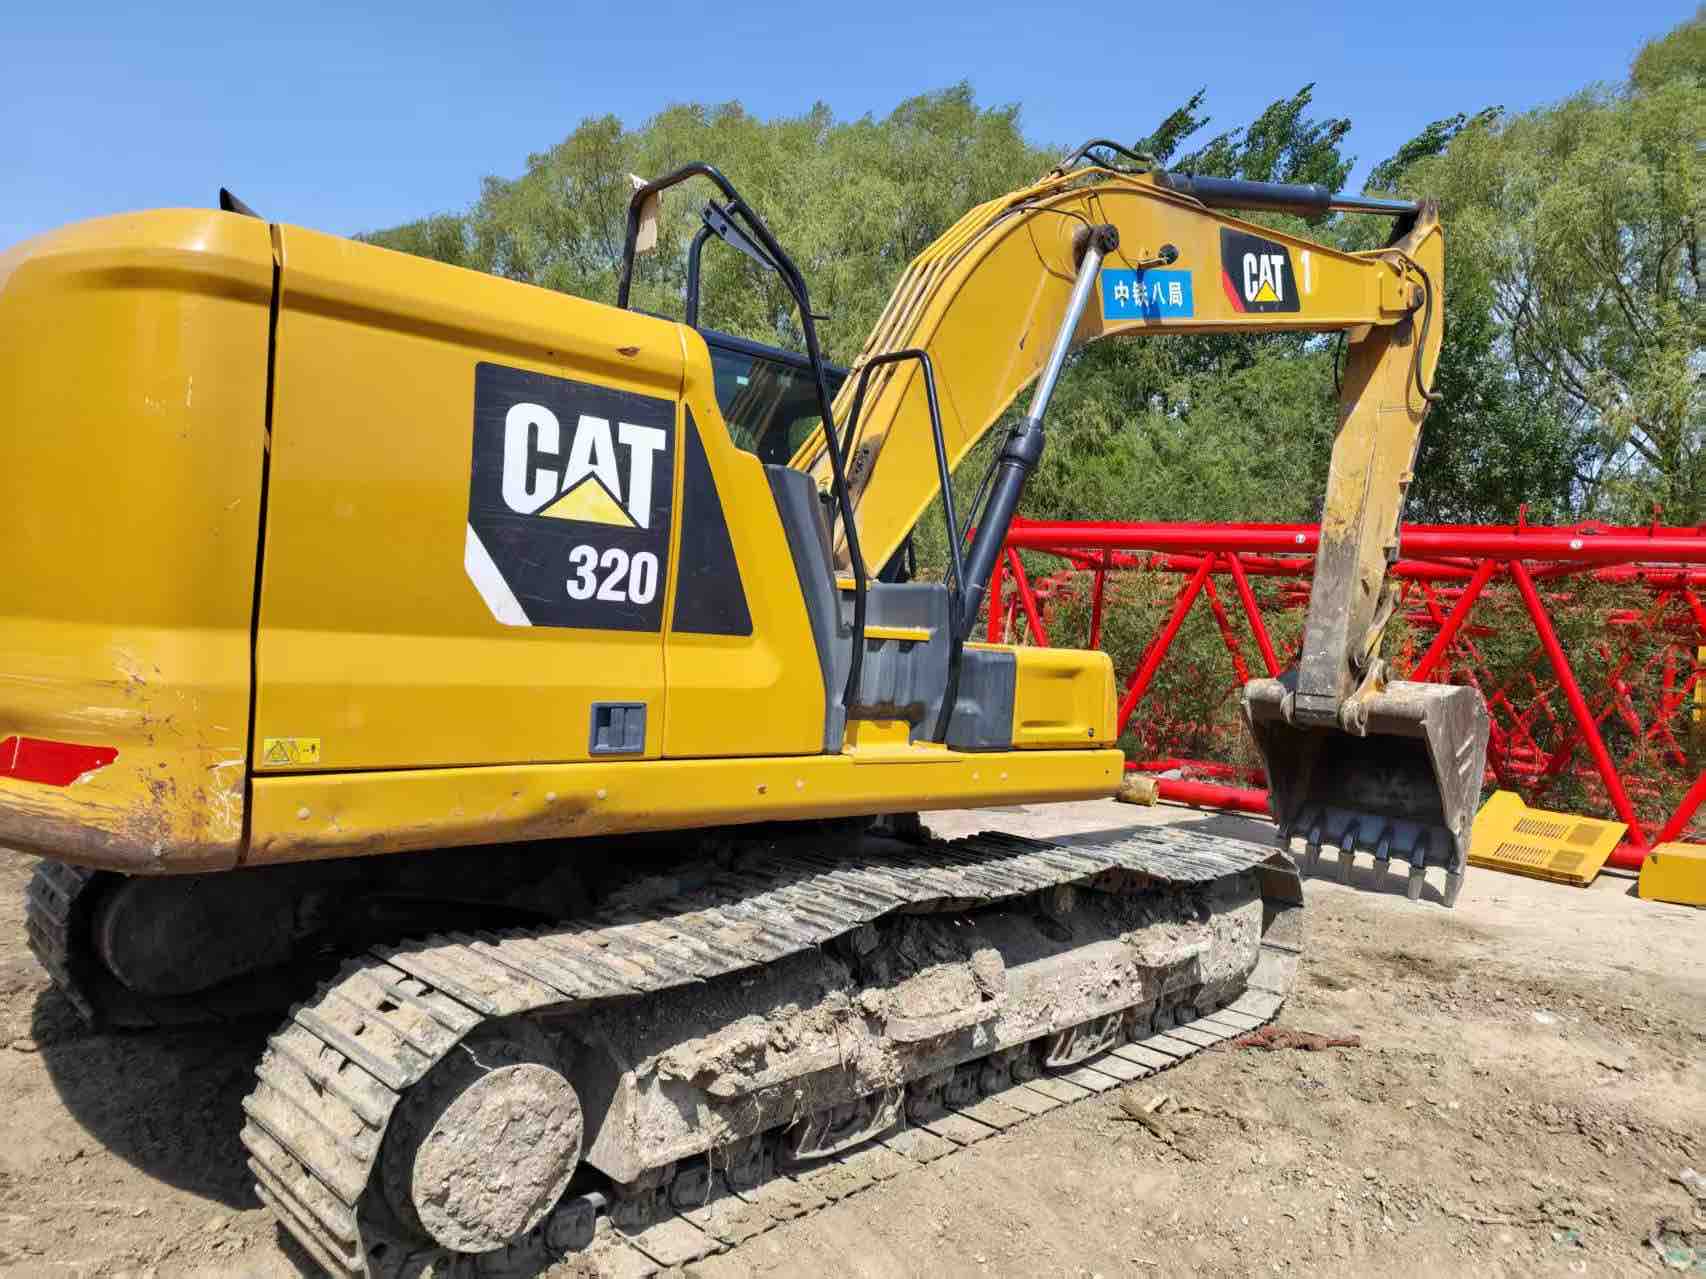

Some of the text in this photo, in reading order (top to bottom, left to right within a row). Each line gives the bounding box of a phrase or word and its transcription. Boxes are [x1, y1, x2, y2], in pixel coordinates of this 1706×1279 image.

[1243, 252, 1285, 302] CAT
[1302, 249, 1312, 294] 1
[502, 402, 666, 529] CAT
[566, 544, 659, 605] 320
